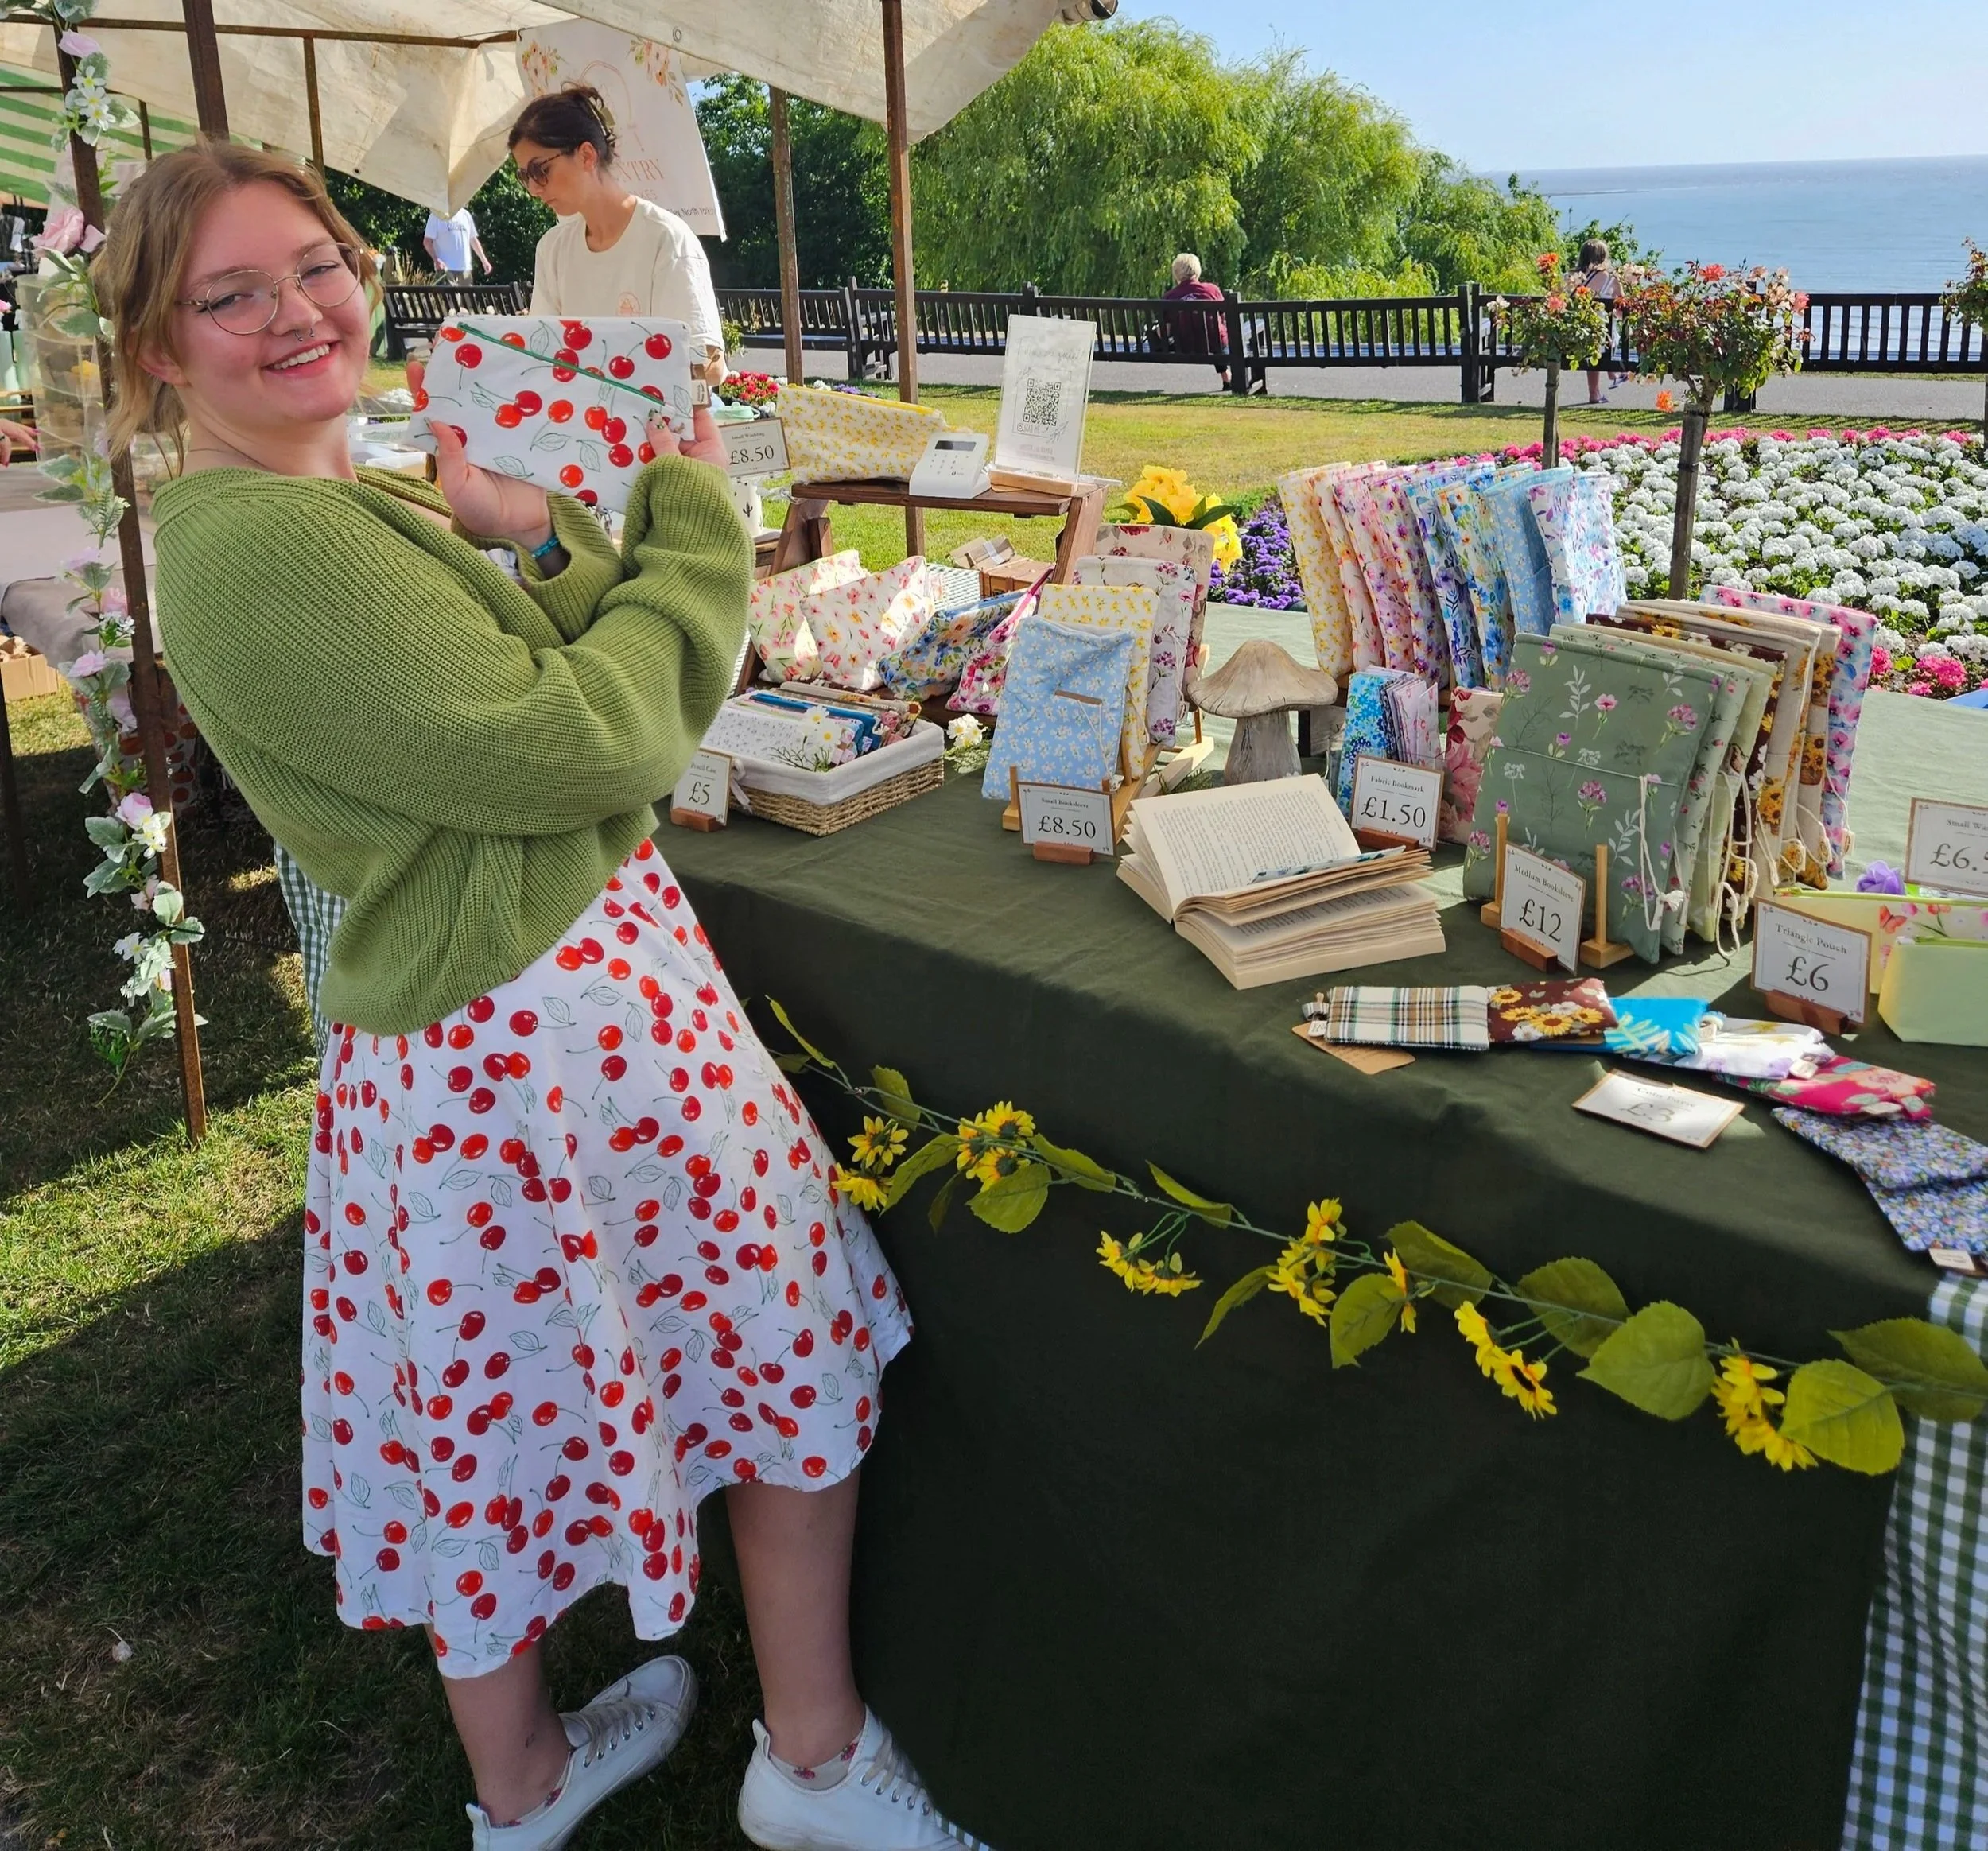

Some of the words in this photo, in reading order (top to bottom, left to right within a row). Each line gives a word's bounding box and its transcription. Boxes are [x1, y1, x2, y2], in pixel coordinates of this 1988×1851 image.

[615, 158, 665, 182] NTRY
[729, 444, 775, 466] £8.50
[688, 781, 711, 805] £5
[1370, 775, 1391, 786] Fabric
[1392, 780, 1424, 793] Bookmark
[1361, 796, 1426, 828] £1.50
[1038, 815, 1097, 839] £8.50
[1514, 864, 1541, 883] Medium
[1542, 878, 1574, 903] Booksleeve
[1519, 898, 1562, 944] £12
[1775, 922, 1814, 945] Triangle
[1816, 937, 1848, 955] Pouch
[1785, 956, 1829, 992] £6
[1637, 1087, 1663, 1099] Coin
[1619, 1102, 1675, 1123] £3
